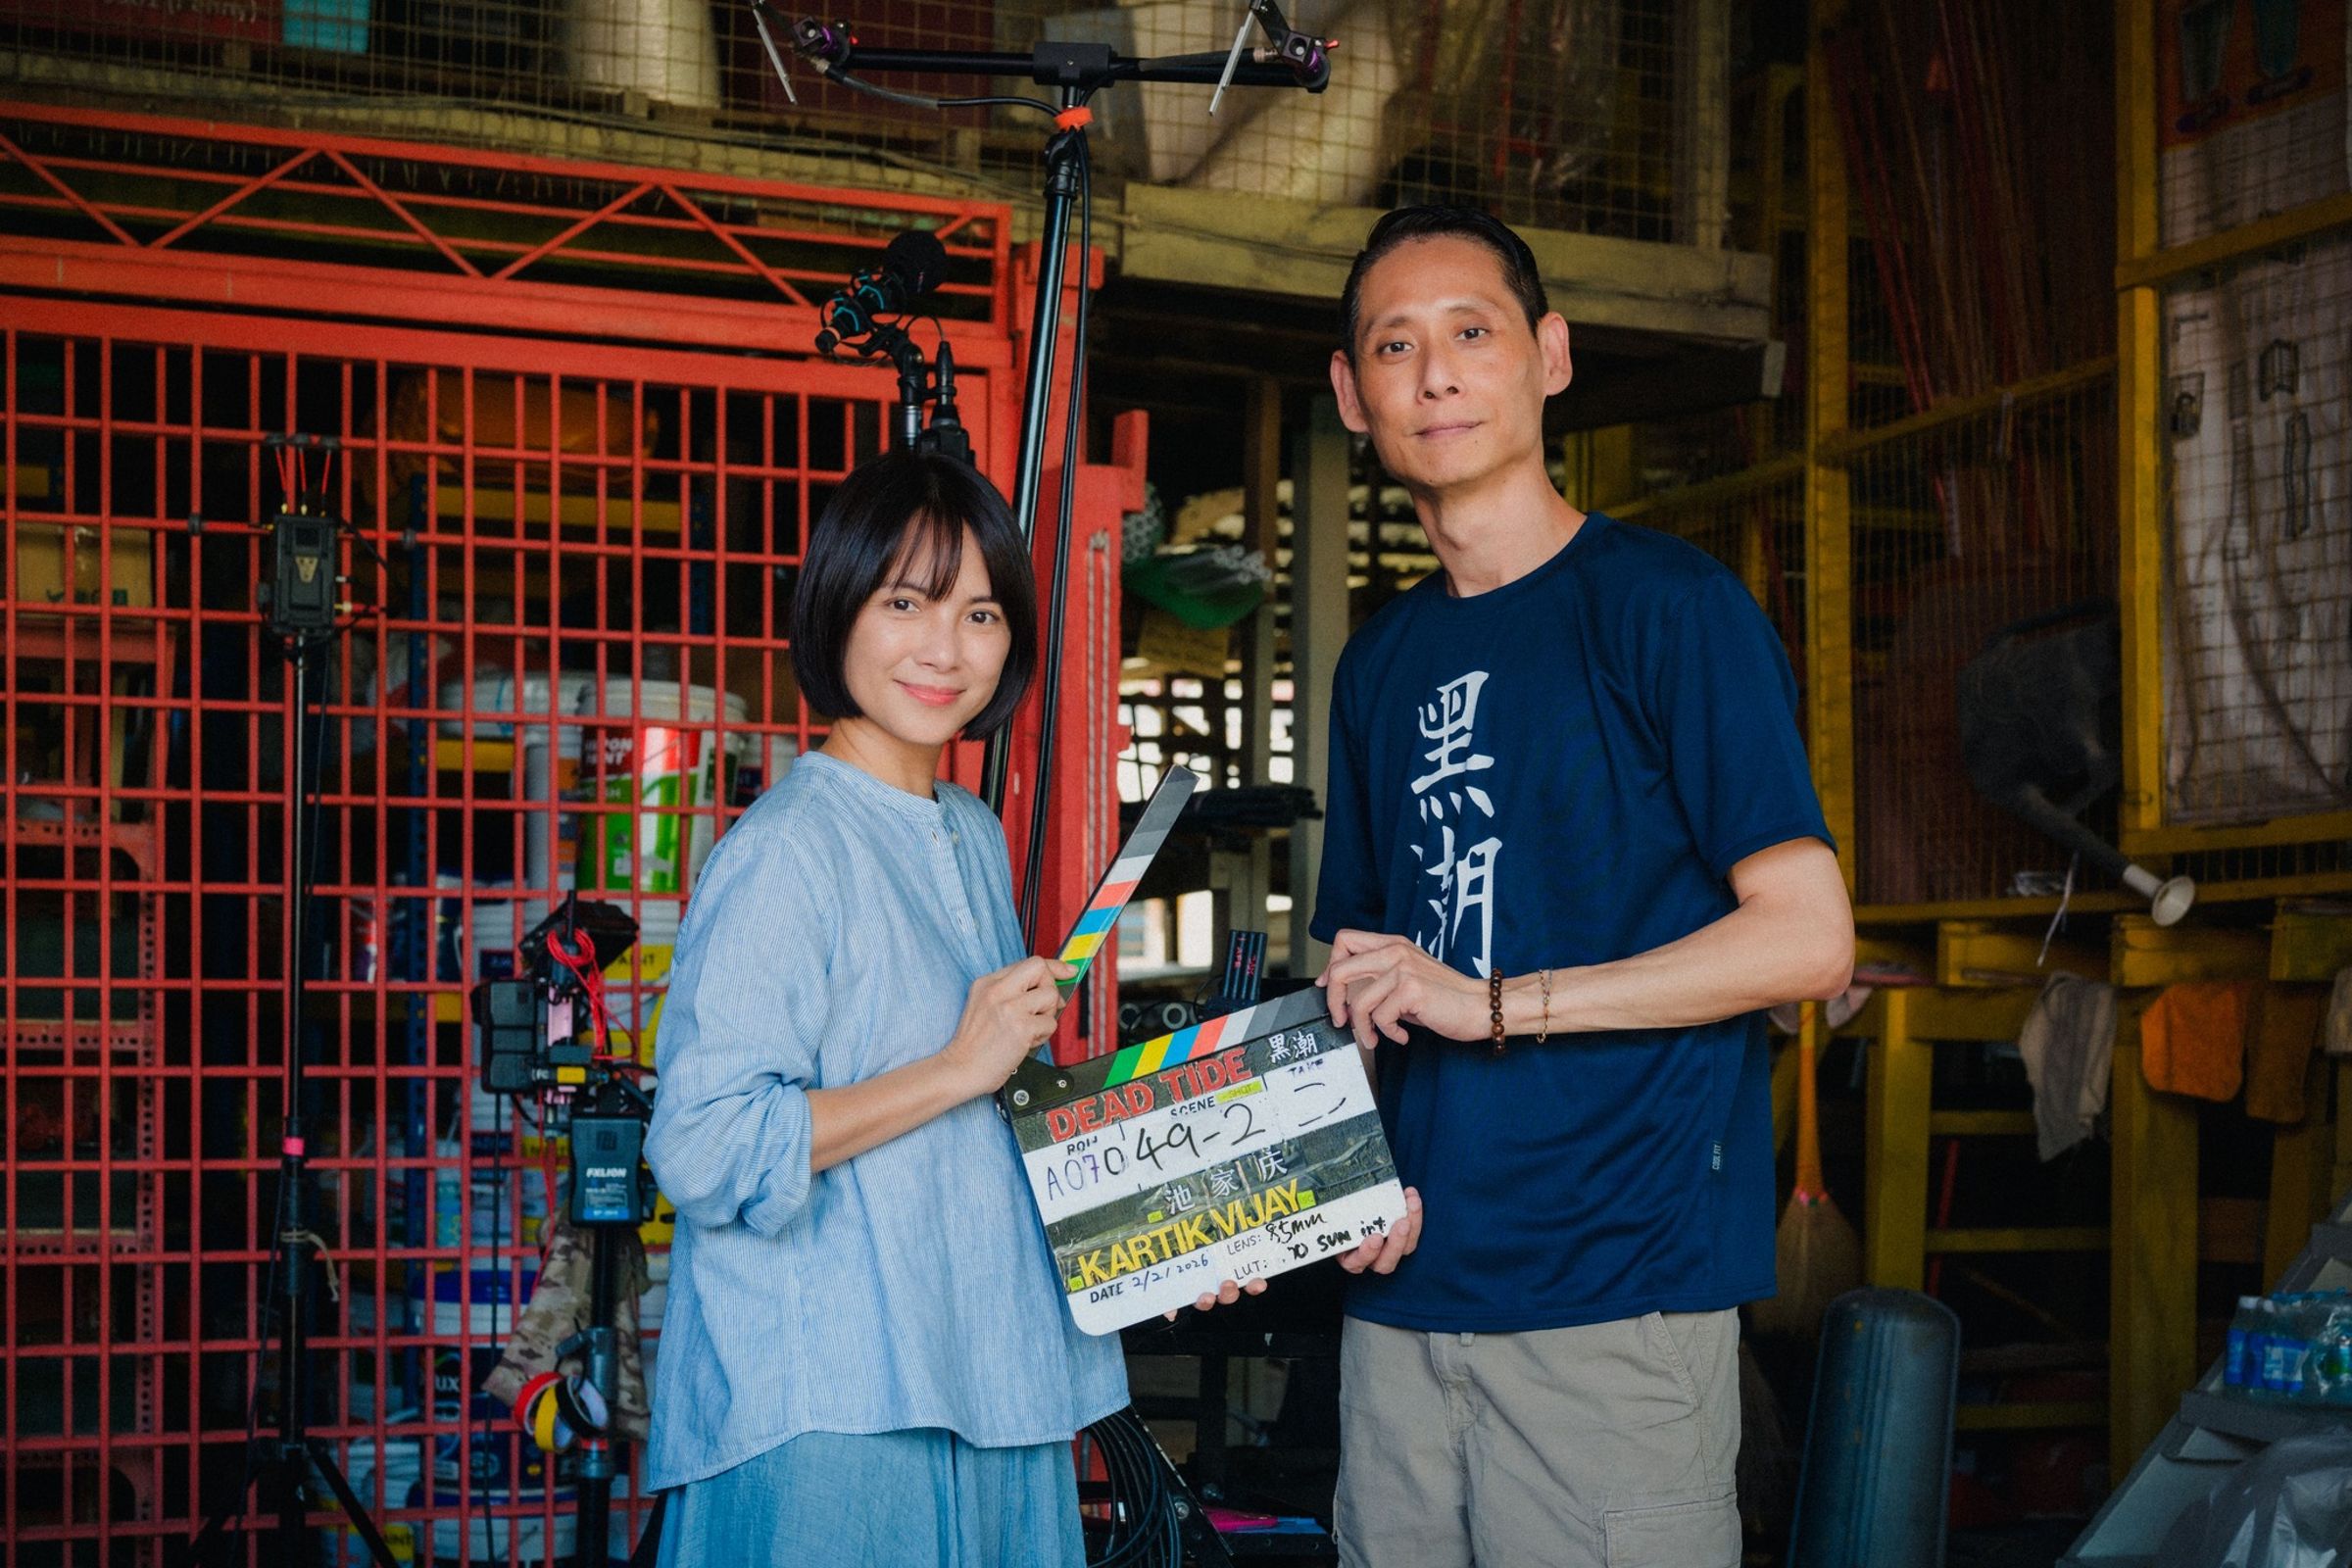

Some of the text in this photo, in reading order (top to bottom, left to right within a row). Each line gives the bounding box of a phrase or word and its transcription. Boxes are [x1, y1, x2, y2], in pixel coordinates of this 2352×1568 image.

[1045, 1046, 1253, 1144] DEAD TIDE
[1170, 1095, 1217, 1117] SCENE
[585, 1167, 628, 1179] FXLION
[1164, 1147, 1288, 1215] 池家庆
[1078, 1178, 1301, 1288] KARTIK VIJAY
[1090, 1281, 1124, 1303] DATE
